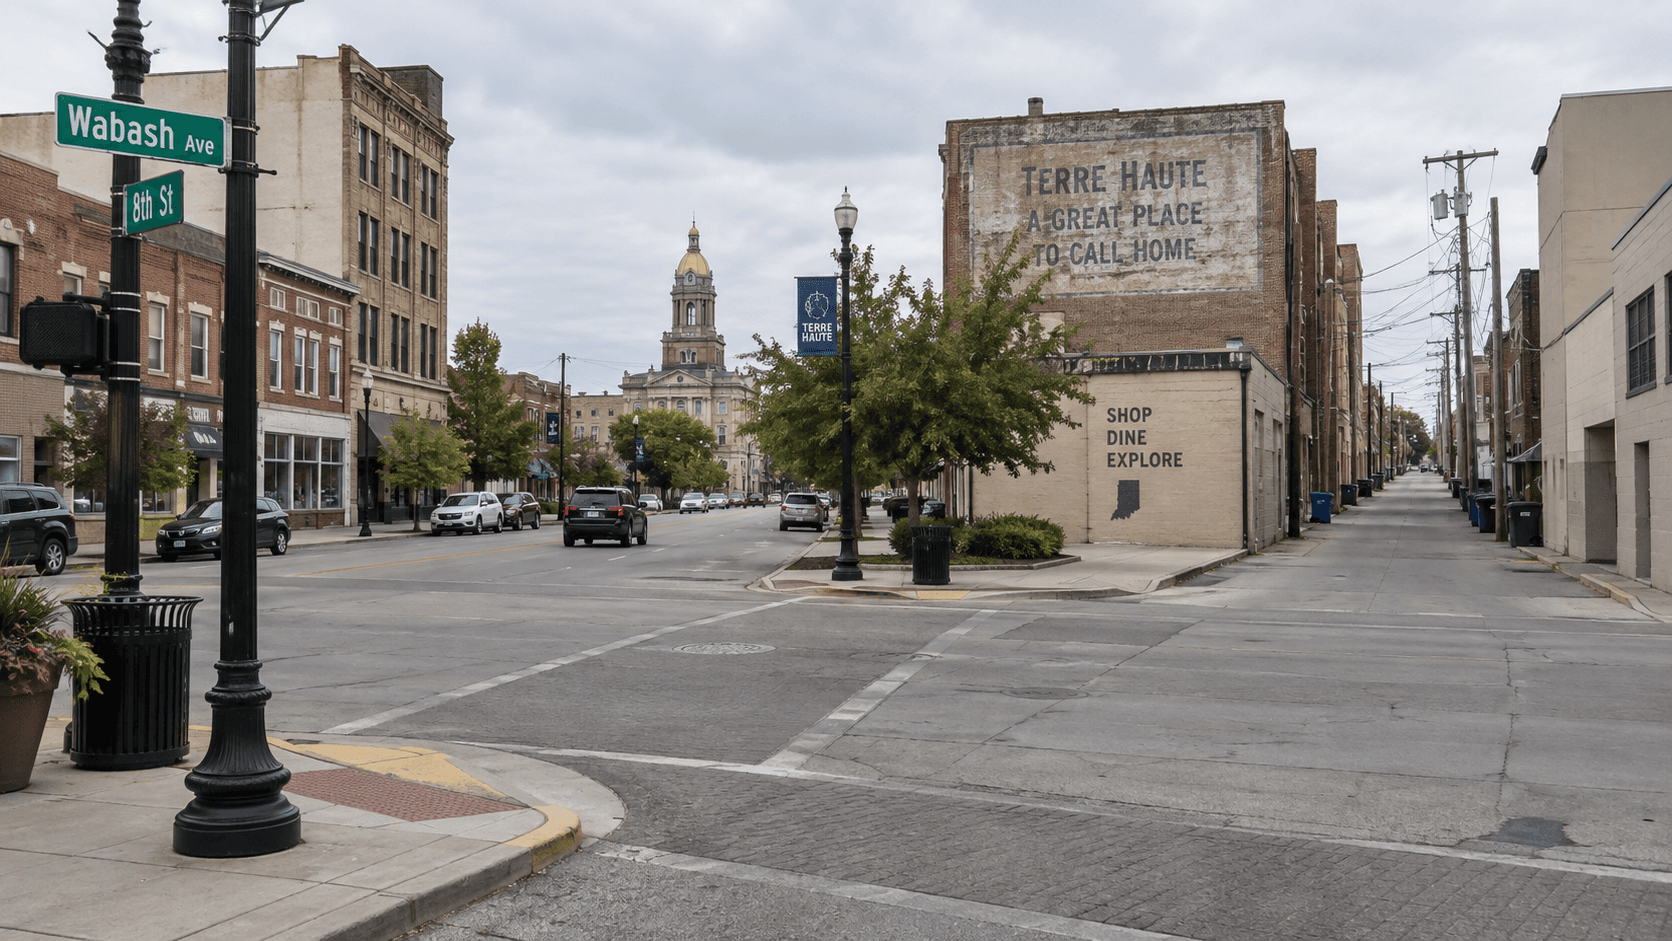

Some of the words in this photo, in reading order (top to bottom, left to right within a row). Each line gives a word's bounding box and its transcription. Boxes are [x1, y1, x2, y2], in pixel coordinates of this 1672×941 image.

[67, 103, 175, 150] Wabash
[184, 134, 215, 155] Ave
[1021, 165, 1107, 196] TERRE
[1121, 159, 1207, 191] HAUTE
[133, 189, 153, 223] 8th
[159, 184, 174, 217] St
[1026, 210, 1042, 232] A
[1051, 205, 1122, 230] GREAT
[1133, 202, 1203, 227] PLACE
[1033, 243, 1060, 267] TO
[1070, 240, 1124, 265] CALL
[1133, 237, 1197, 262] HOME
[802, 323, 833, 332] TERRE
[802, 332, 833, 342] HAUTE
[1107, 407, 1152, 423] SHOP
[1107, 430, 1147, 445] DINE
[1107, 452, 1183, 468] EXPLORE
